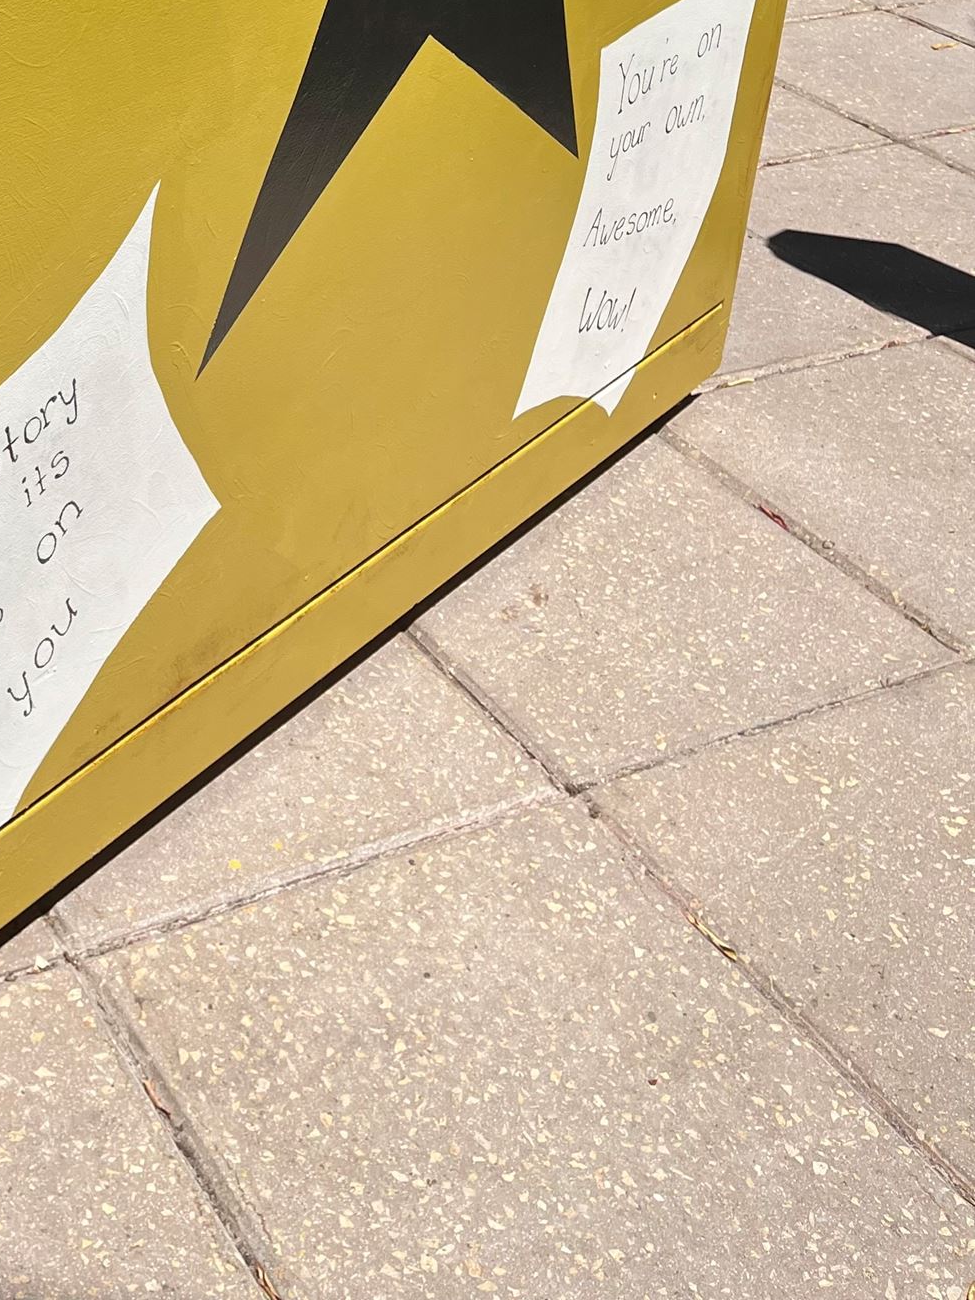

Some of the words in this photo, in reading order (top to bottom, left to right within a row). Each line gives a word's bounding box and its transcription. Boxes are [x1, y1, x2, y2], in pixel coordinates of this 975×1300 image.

[617, 37, 679, 115] You're
[697, 23, 723, 58] on
[606, 123, 651, 182] your
[578, 287, 637, 334] Wow!
[23, 450, 70, 507] its
[36, 499, 83, 564] on
[7, 597, 78, 717] you
